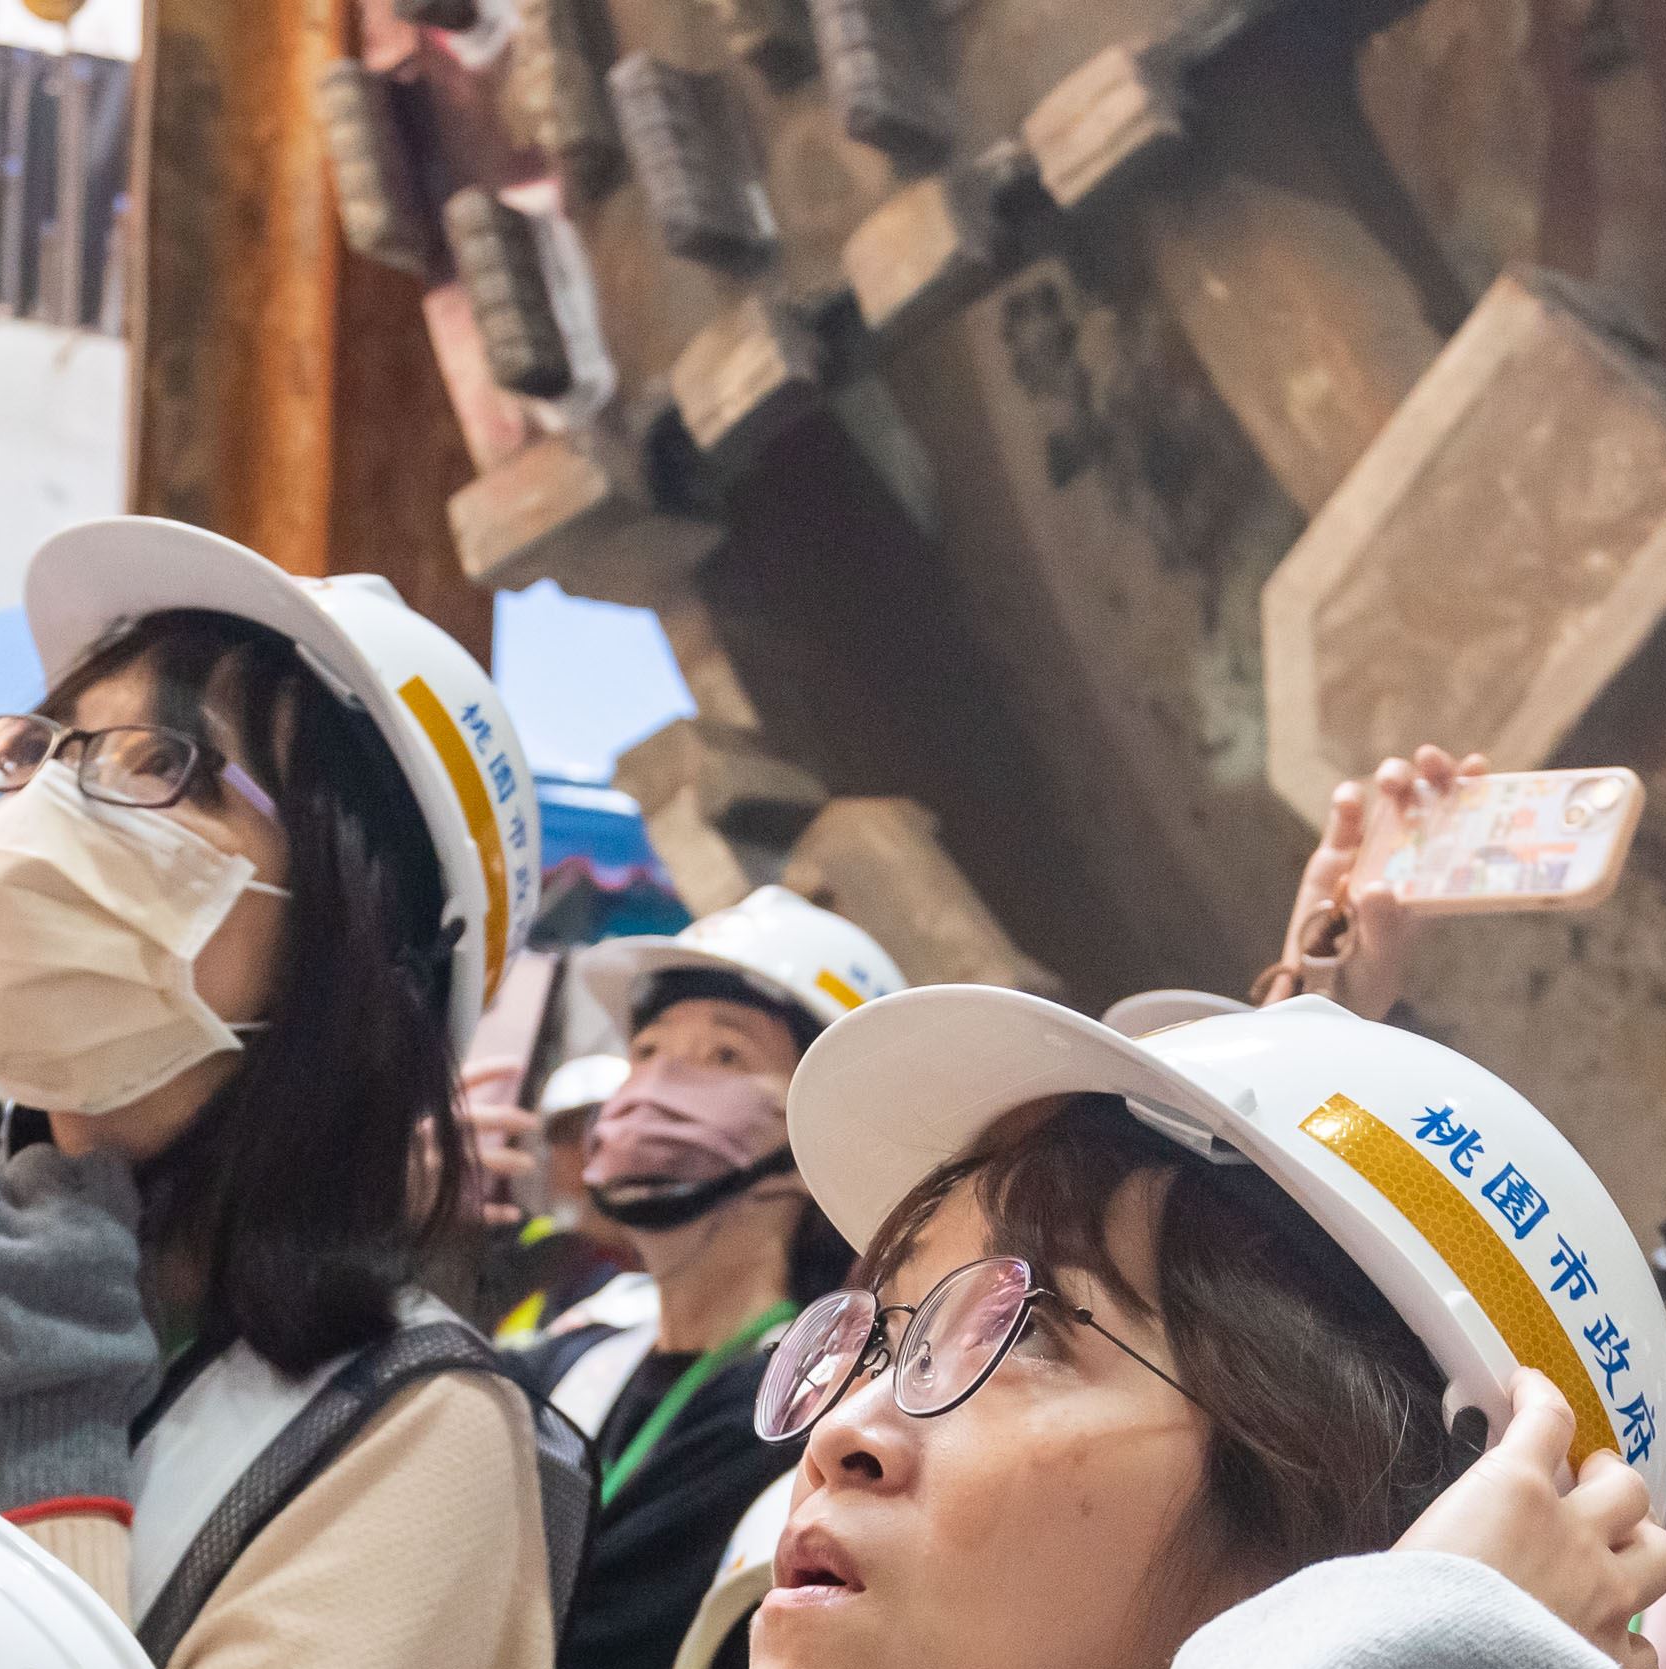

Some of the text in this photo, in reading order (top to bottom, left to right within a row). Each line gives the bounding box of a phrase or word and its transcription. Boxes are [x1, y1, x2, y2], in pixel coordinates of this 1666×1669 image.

[1410, 1103, 1656, 1465] 桃園市政府
